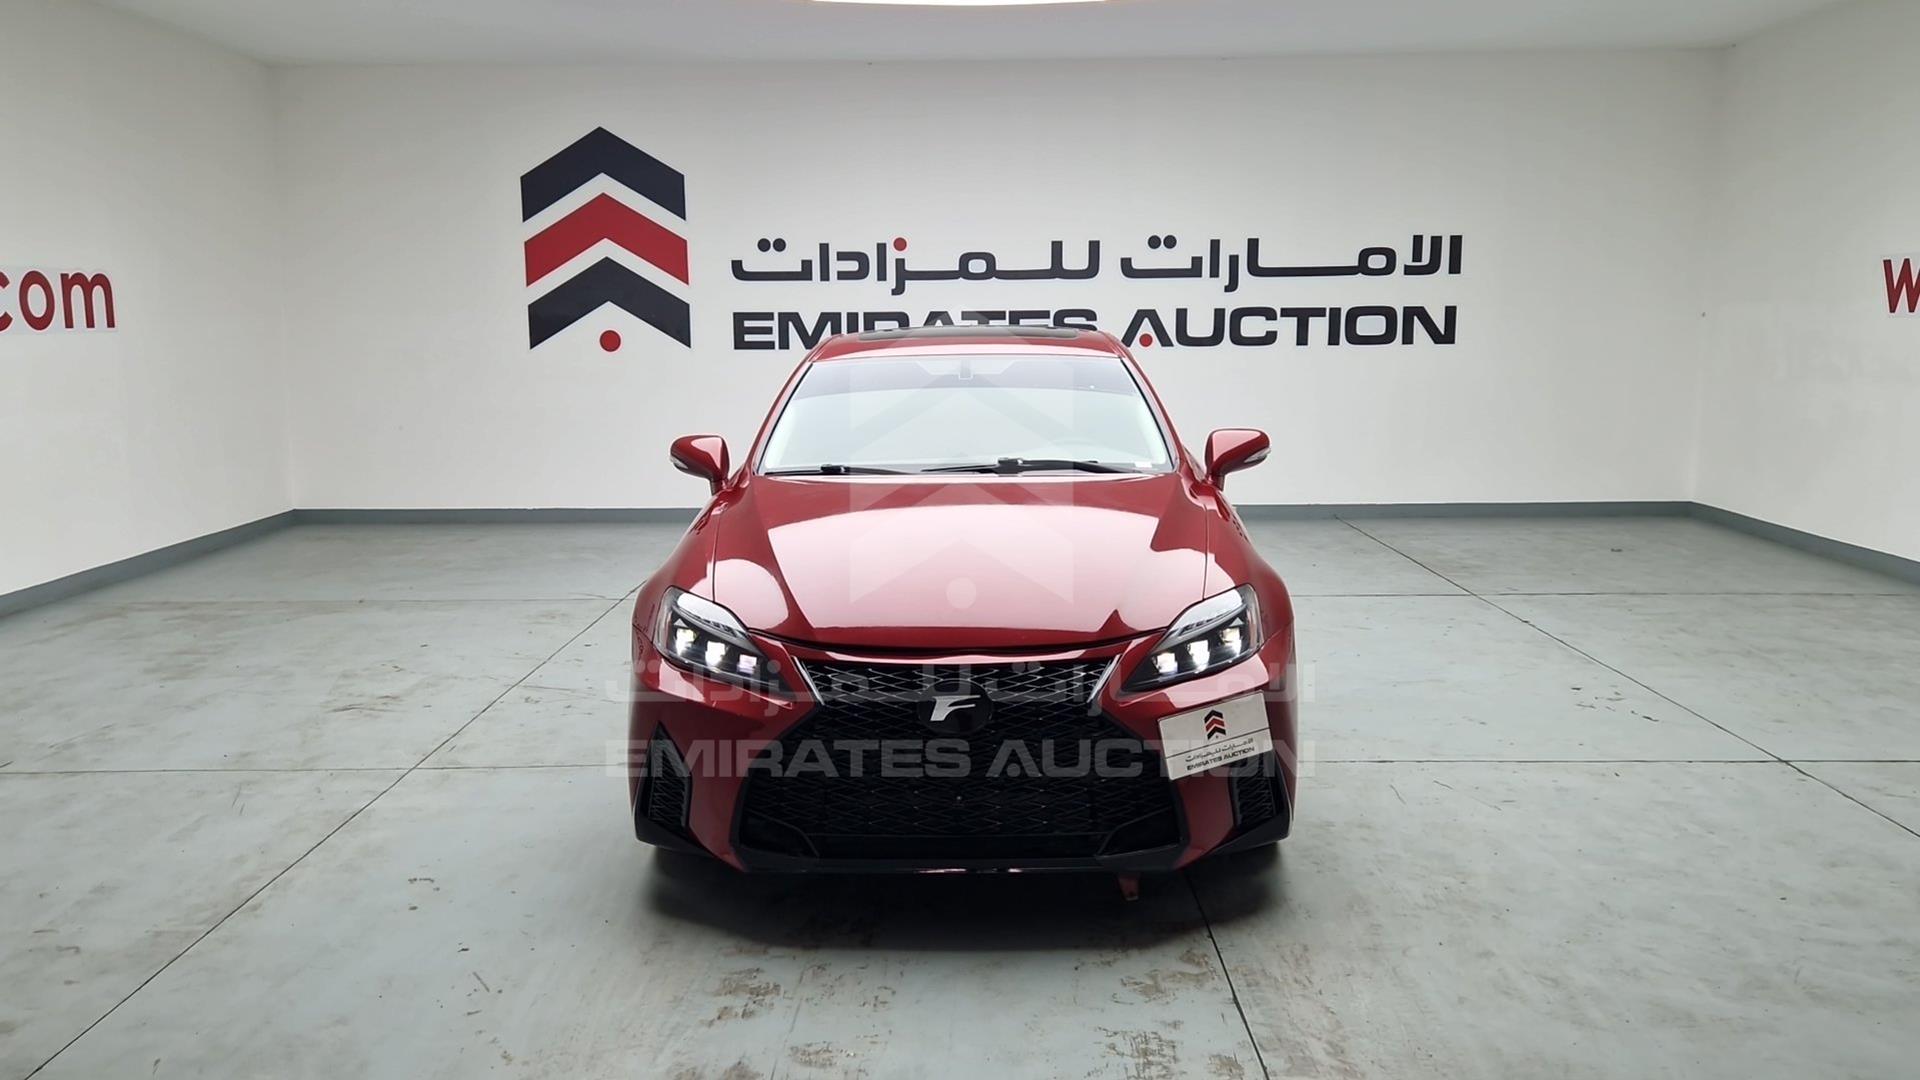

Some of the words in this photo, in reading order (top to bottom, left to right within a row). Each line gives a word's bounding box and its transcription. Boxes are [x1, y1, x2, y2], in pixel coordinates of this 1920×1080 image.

[731, 237, 1101, 295] للمزادات
[1120, 234, 1463, 293] الامارات
[1120, 305, 1458, 348] AUCTION
